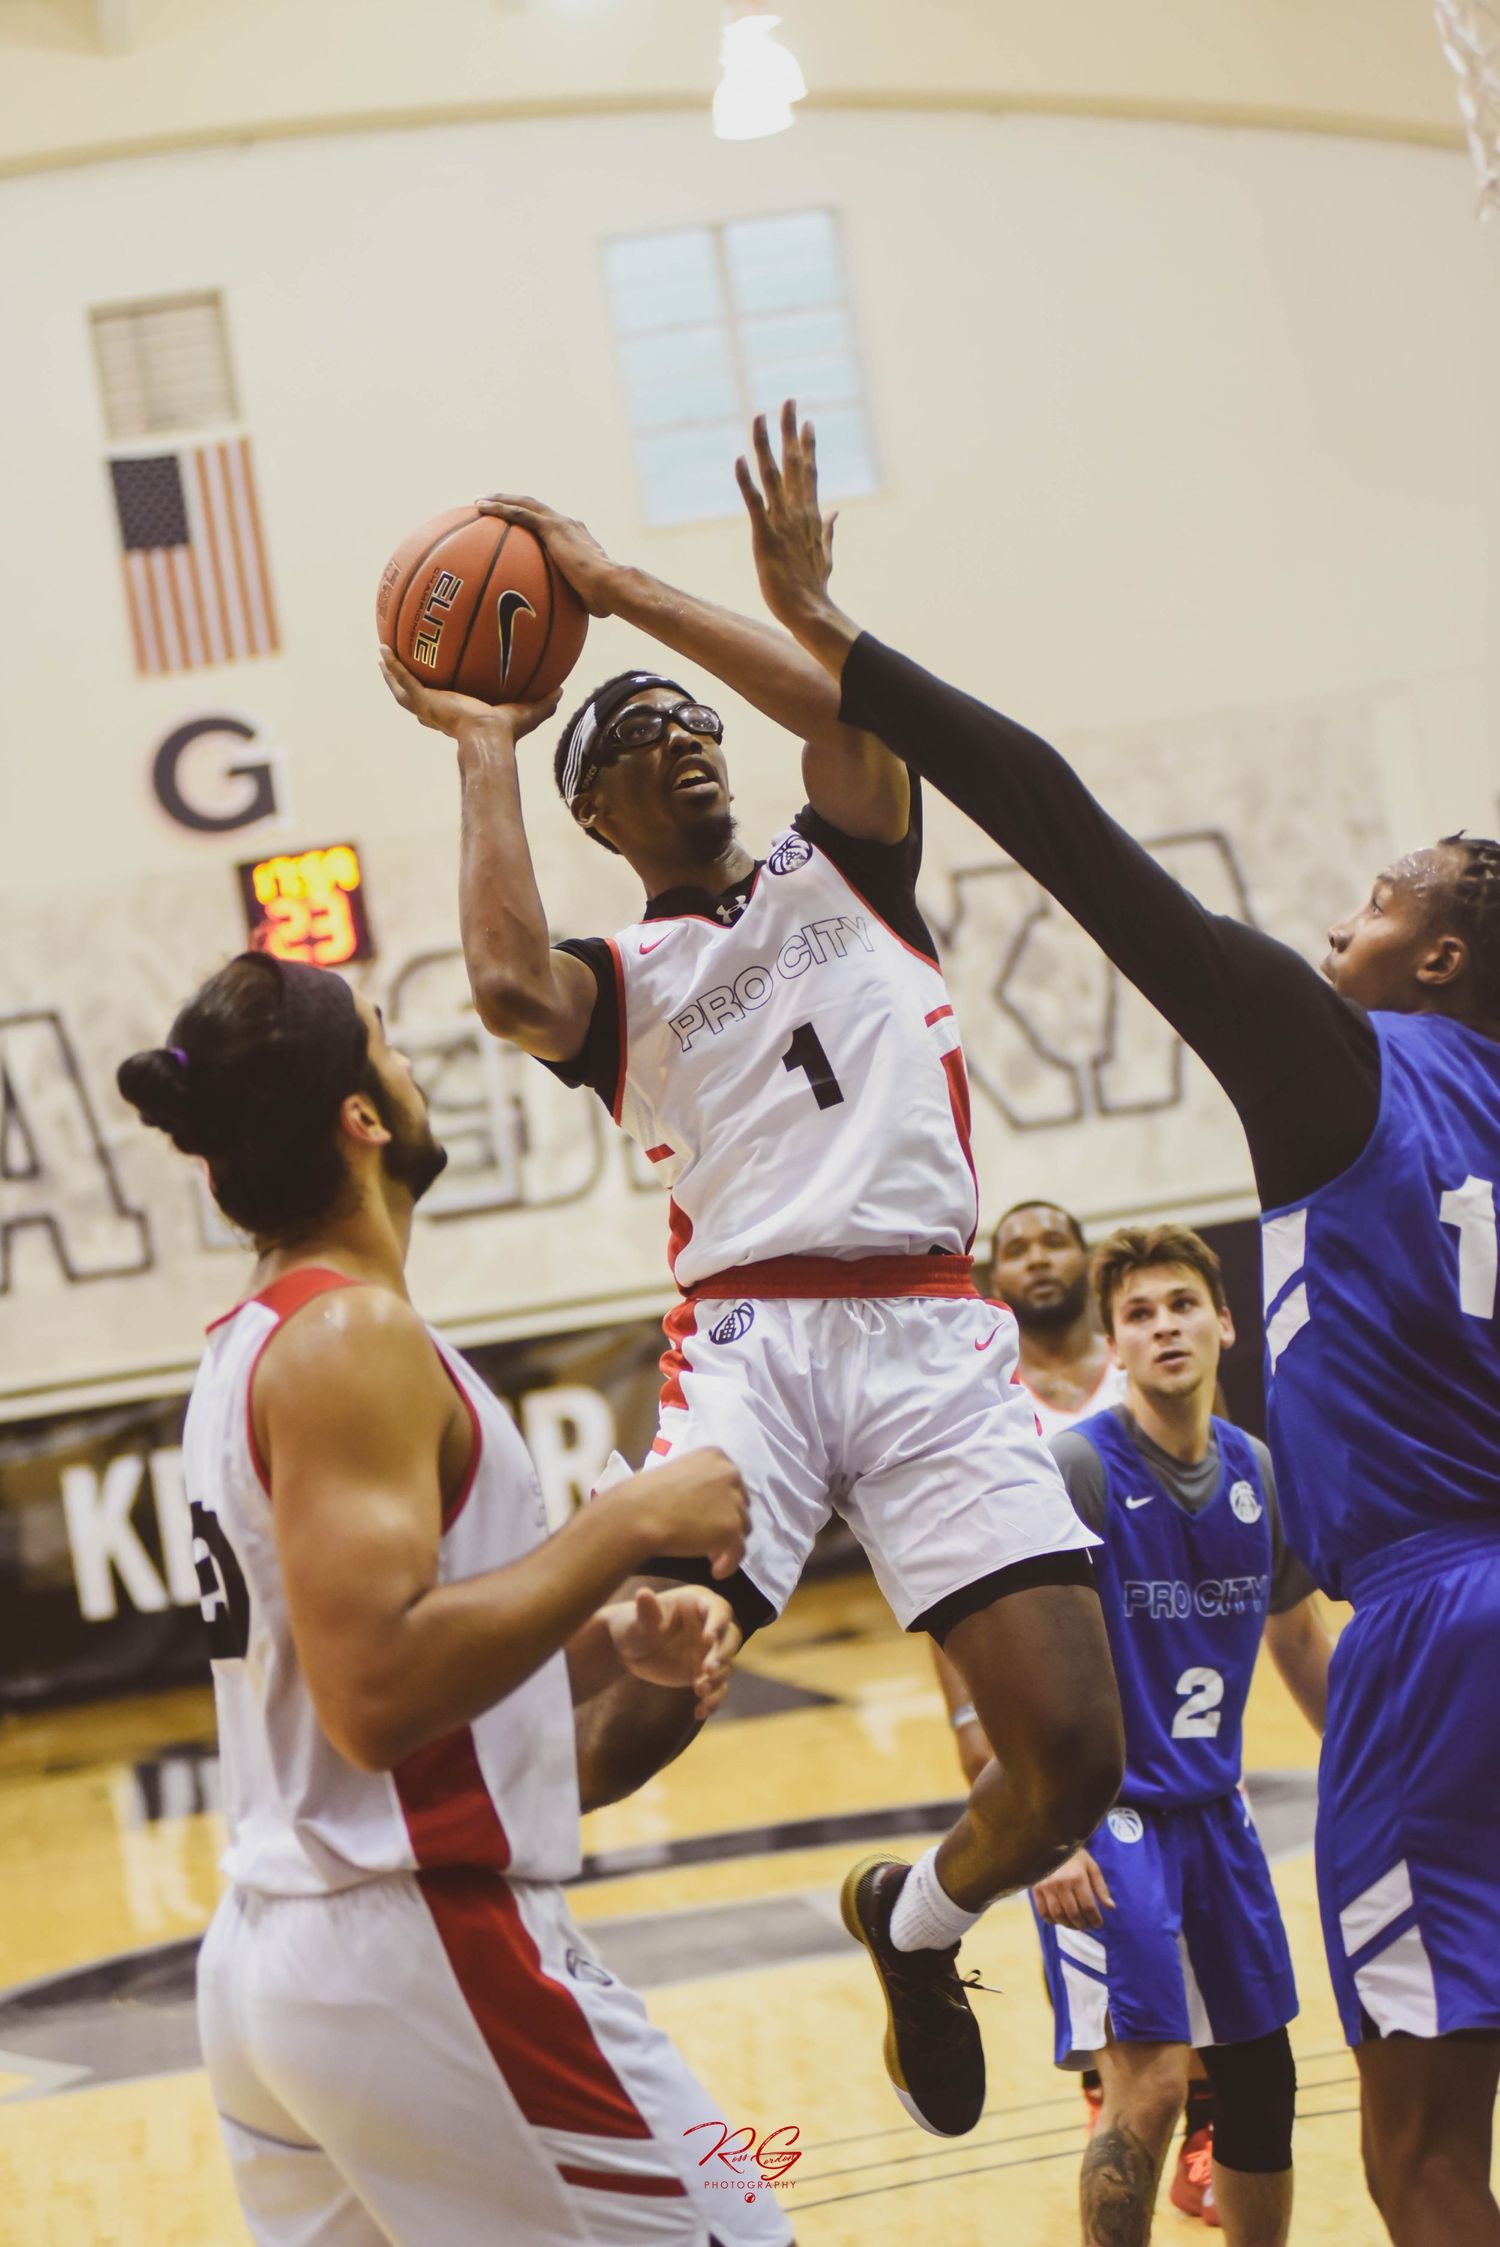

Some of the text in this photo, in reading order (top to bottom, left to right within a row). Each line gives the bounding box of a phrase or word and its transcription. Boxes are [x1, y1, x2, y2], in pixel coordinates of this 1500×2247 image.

[413, 570, 464, 668] ELITE
[152, 717, 277, 833] G
[668, 915, 875, 1053] PRO CITY
[781, 1021, 845, 1111] 1
[1123, 1574, 1268, 1619] PRO CITY
[1171, 1666, 1224, 1738] 2
